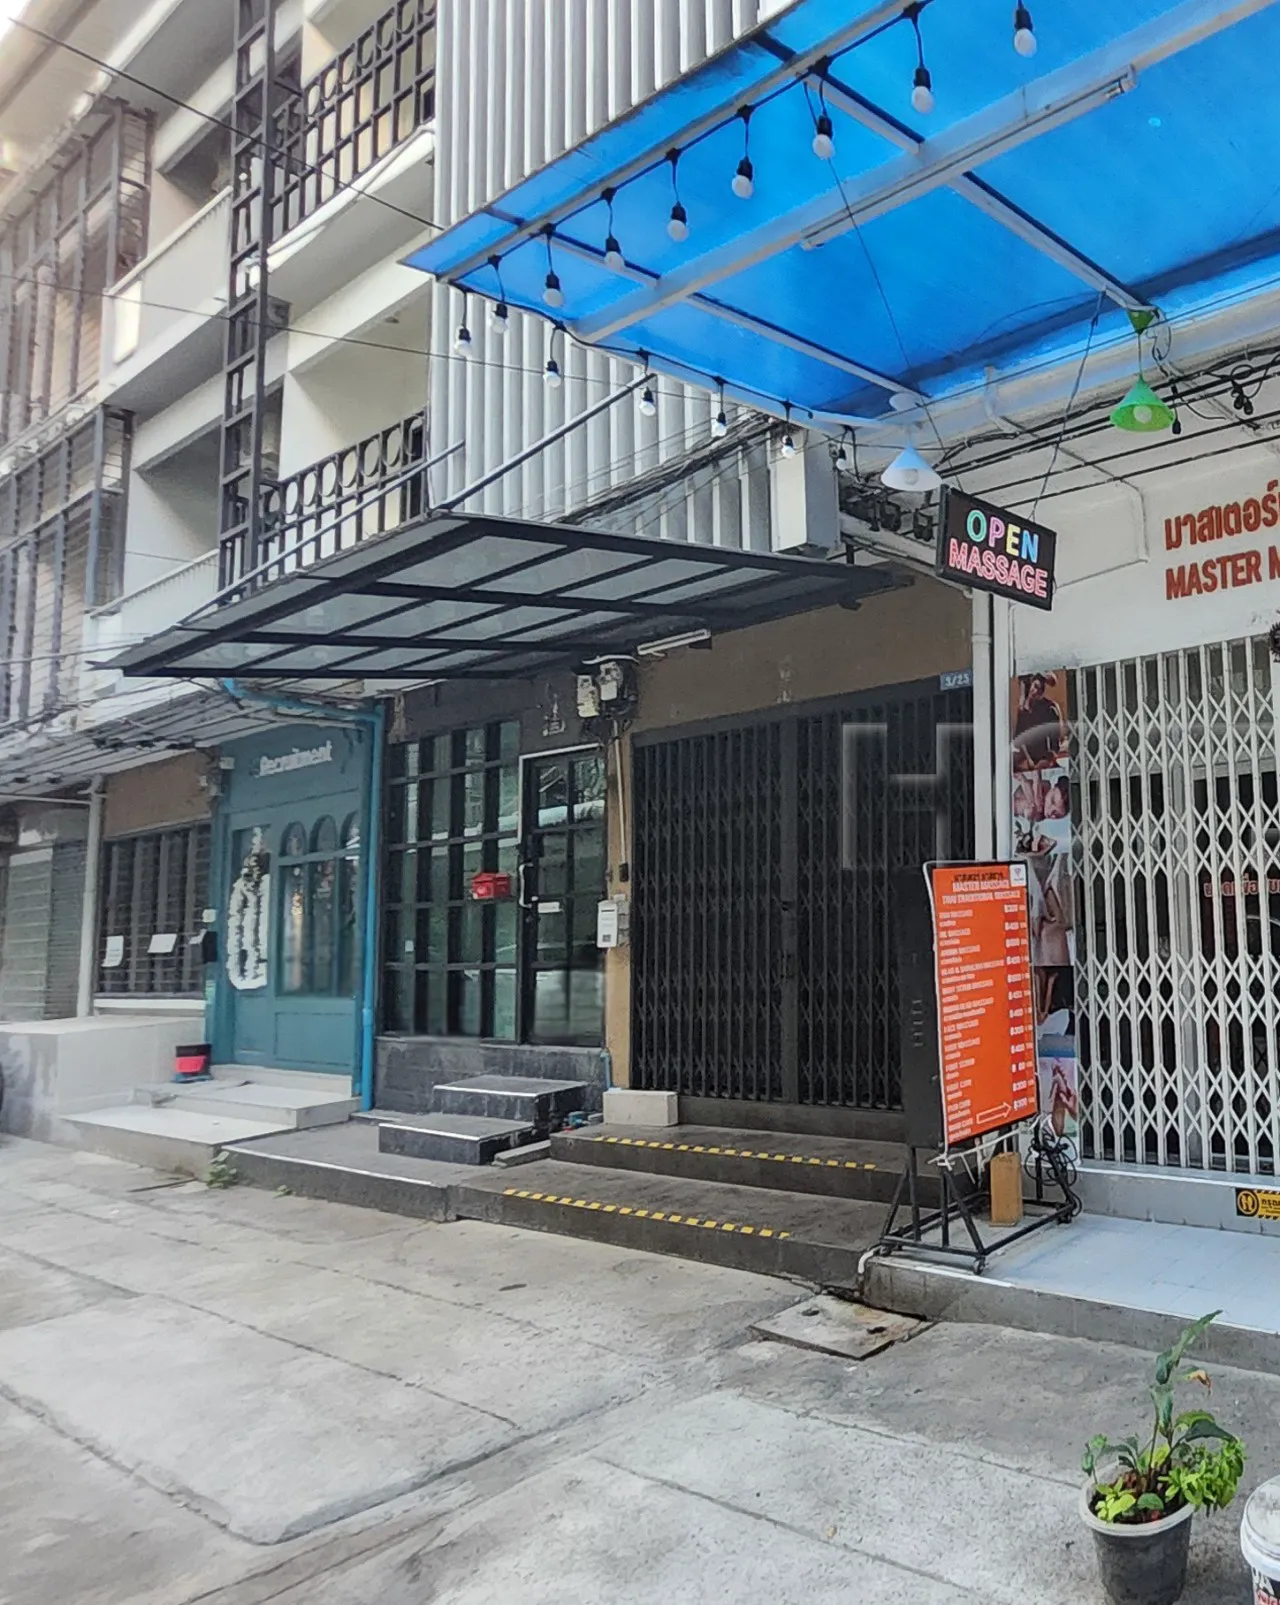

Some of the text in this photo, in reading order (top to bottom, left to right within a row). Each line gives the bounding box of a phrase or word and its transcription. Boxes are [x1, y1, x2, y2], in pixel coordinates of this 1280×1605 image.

[966, 509, 1039, 563] OPEN
[948, 537, 1048, 599] MASSAGE
[1165, 550, 1262, 600] MASTER
